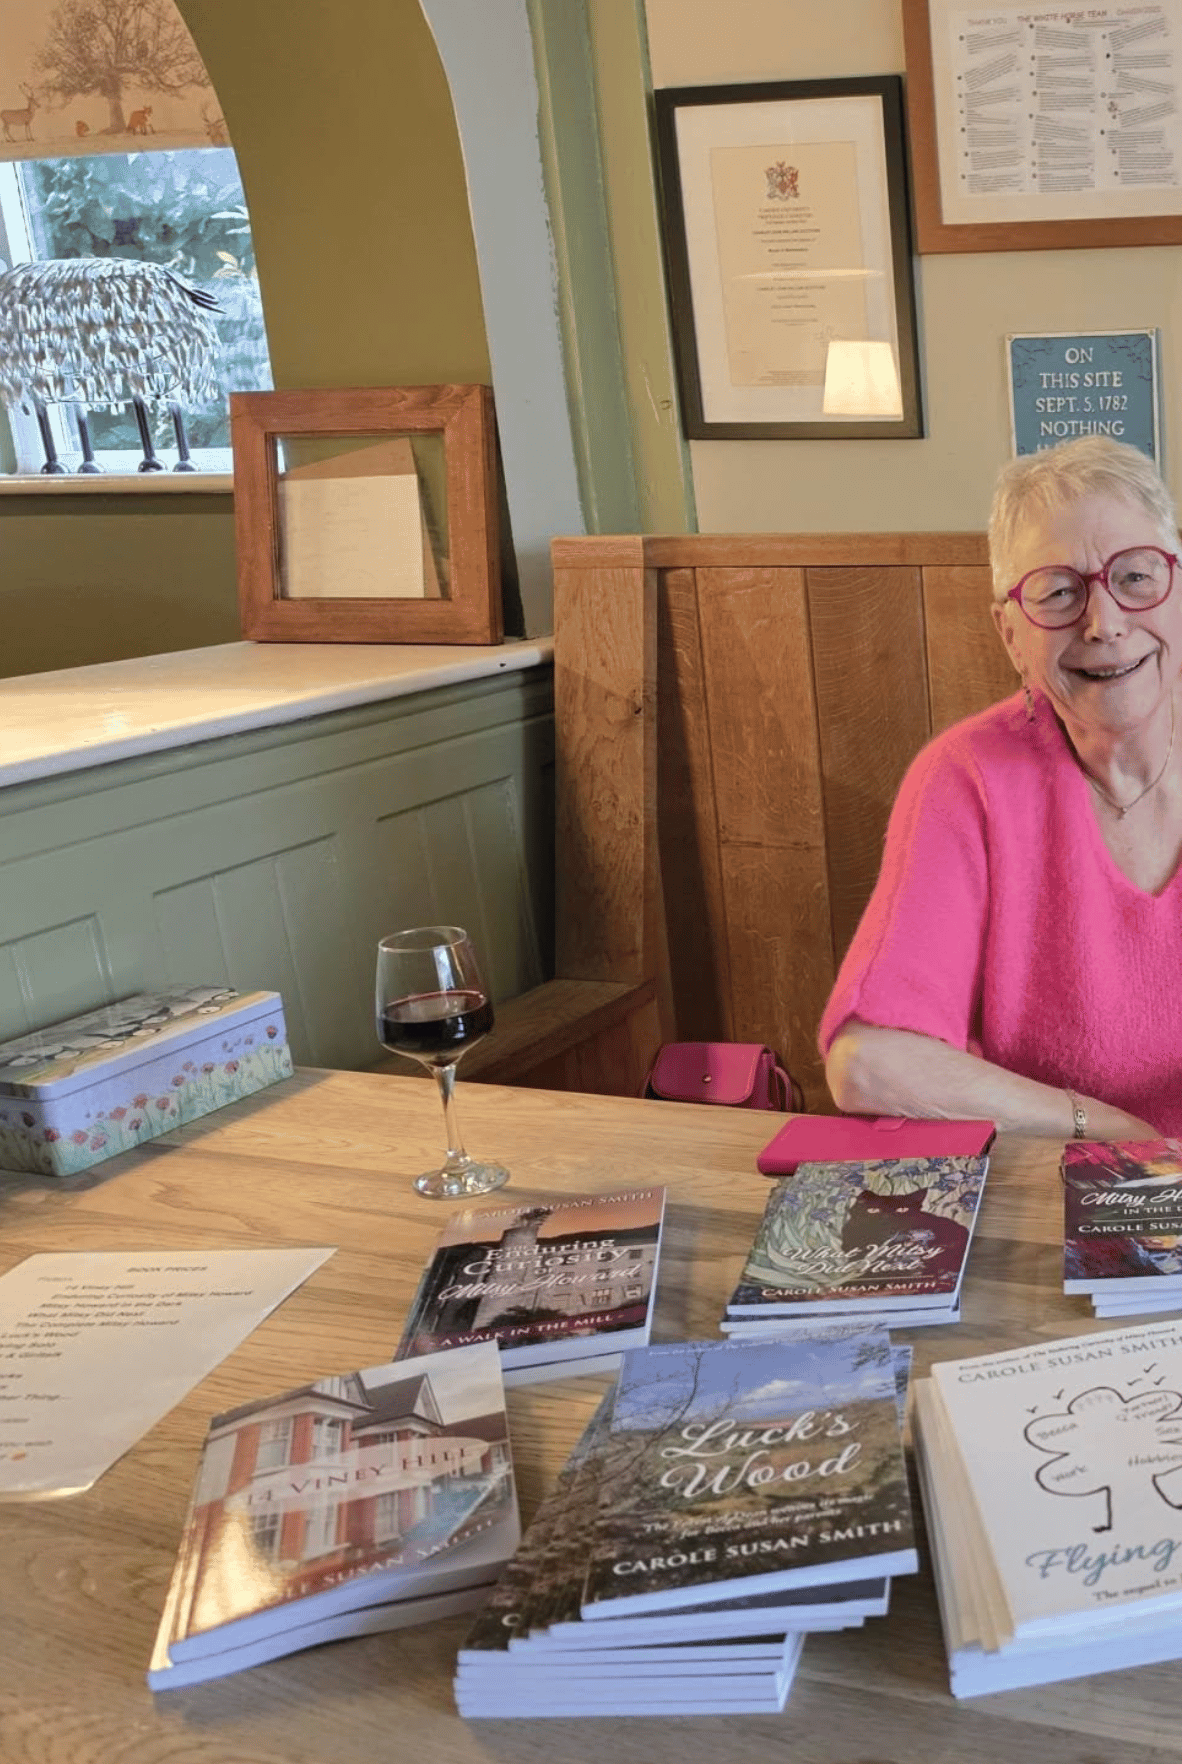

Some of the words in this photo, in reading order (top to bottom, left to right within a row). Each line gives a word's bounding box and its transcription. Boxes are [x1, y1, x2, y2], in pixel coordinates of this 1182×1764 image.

[1060, 11, 1085, 20] HORSE
[1087, 10, 1107, 18] TEAM
[1065, 347, 1093, 364] ON
[1039, 372, 1080, 388] THIS
[1083, 371, 1123, 387] SITE
[1035, 396, 1080, 413] SEPT.
[1083, 396, 1095, 413] 5,
[1099, 395, 1128, 411] 1782
[1040, 420, 1125, 436] NOTHING
[1080, 1191, 1147, 1207] Mitsy
[1144, 1206, 1172, 1214] THE
[1078, 1224, 1143, 1233] CAROLE
[485, 1239, 615, 1260] Enduring
[783, 1246, 862, 1260] What
[866, 1244, 946, 1259] Mitsy
[463, 1249, 631, 1275] Curiosity
[797, 1260, 851, 1274] Did
[850, 1259, 923, 1274] Next
[438, 1282, 522, 1300] Mitsy
[521, 1264, 642, 1291] Howard
[761, 1288, 821, 1296] CAROLE
[830, 1284, 879, 1293] SUSAN
[886, 1281, 936, 1290] SMITH
[440, 1338, 451, 1346] A
[459, 1331, 503, 1344] WALK
[511, 1327, 530, 1337] IN
[536, 1321, 569, 1332] THE
[574, 1314, 614, 1327] MILL
[958, 1361, 1042, 1384] CAROLE
[1048, 1348, 1113, 1368] SUSAN
[661, 1411, 860, 1458] Luck's
[291, 1463, 387, 1494] VINEY
[402, 1448, 469, 1471] HILL
[660, 1442, 862, 1498] Wood
[612, 1548, 717, 1576] CAROLE
[726, 1535, 809, 1559] SUSAN
[818, 1519, 901, 1544] SMITH
[324, 1554, 404, 1585] SUSAN
[1025, 1538, 1182, 1588] Flying
[1092, 1591, 1119, 1601] The
